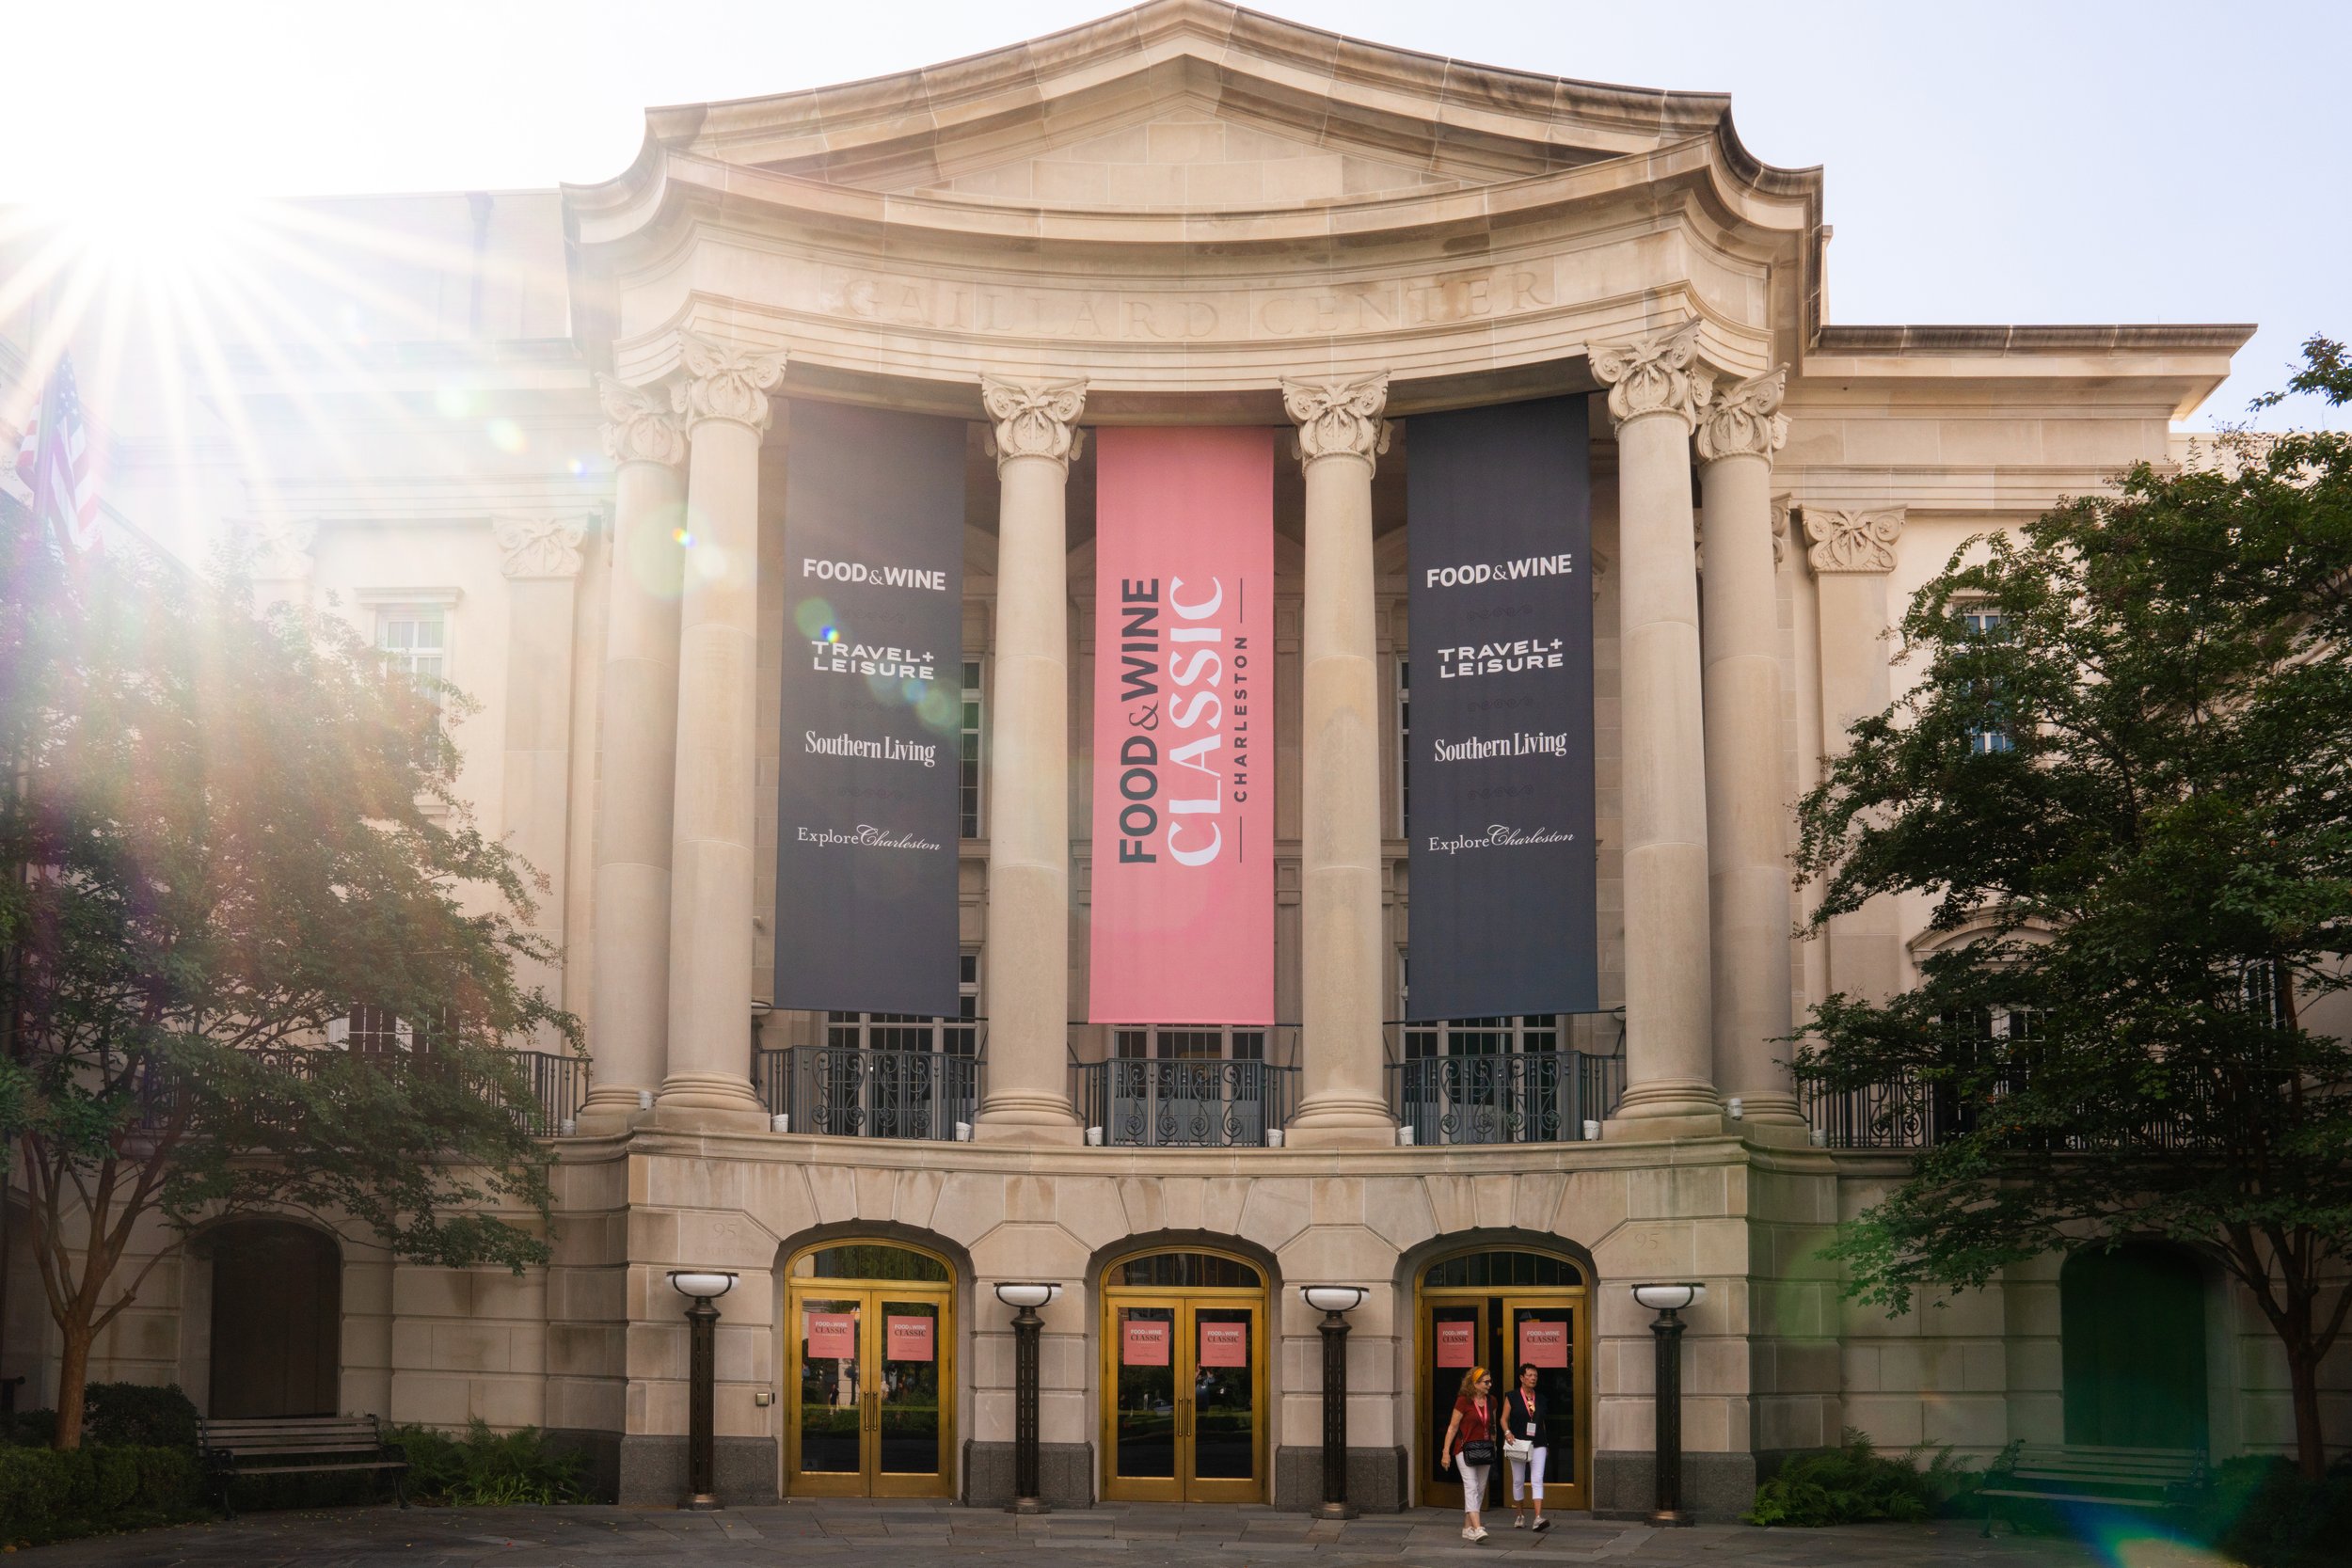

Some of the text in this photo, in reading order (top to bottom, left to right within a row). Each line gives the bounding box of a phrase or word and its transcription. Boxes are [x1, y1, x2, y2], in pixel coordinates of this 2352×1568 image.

[842, 272, 1552, 340] GAILLARD CENTER
[803, 558, 946, 591] FOOD&WINE
[1426, 554, 1572, 588] FOOD&WINE
[811, 641, 934, 663] TRAVEL+
[1438, 638, 1564, 662] TRAVEL+
[813, 657, 934, 680] LEISURE
[1440, 653, 1564, 679] LEISURE
[1168, 576, 1223, 867] CLASSIC
[1233, 637, 1248, 803] CHARLESTON
[805, 730, 936, 768] Southern Living
[1435, 732, 1567, 762] Southern Living
[798, 824, 942, 851] Explore Charleston
[1428, 824, 1575, 855] Explore Charleston
[713, 1222, 739, 1241] 95
[1634, 1230, 1661, 1250] 95
